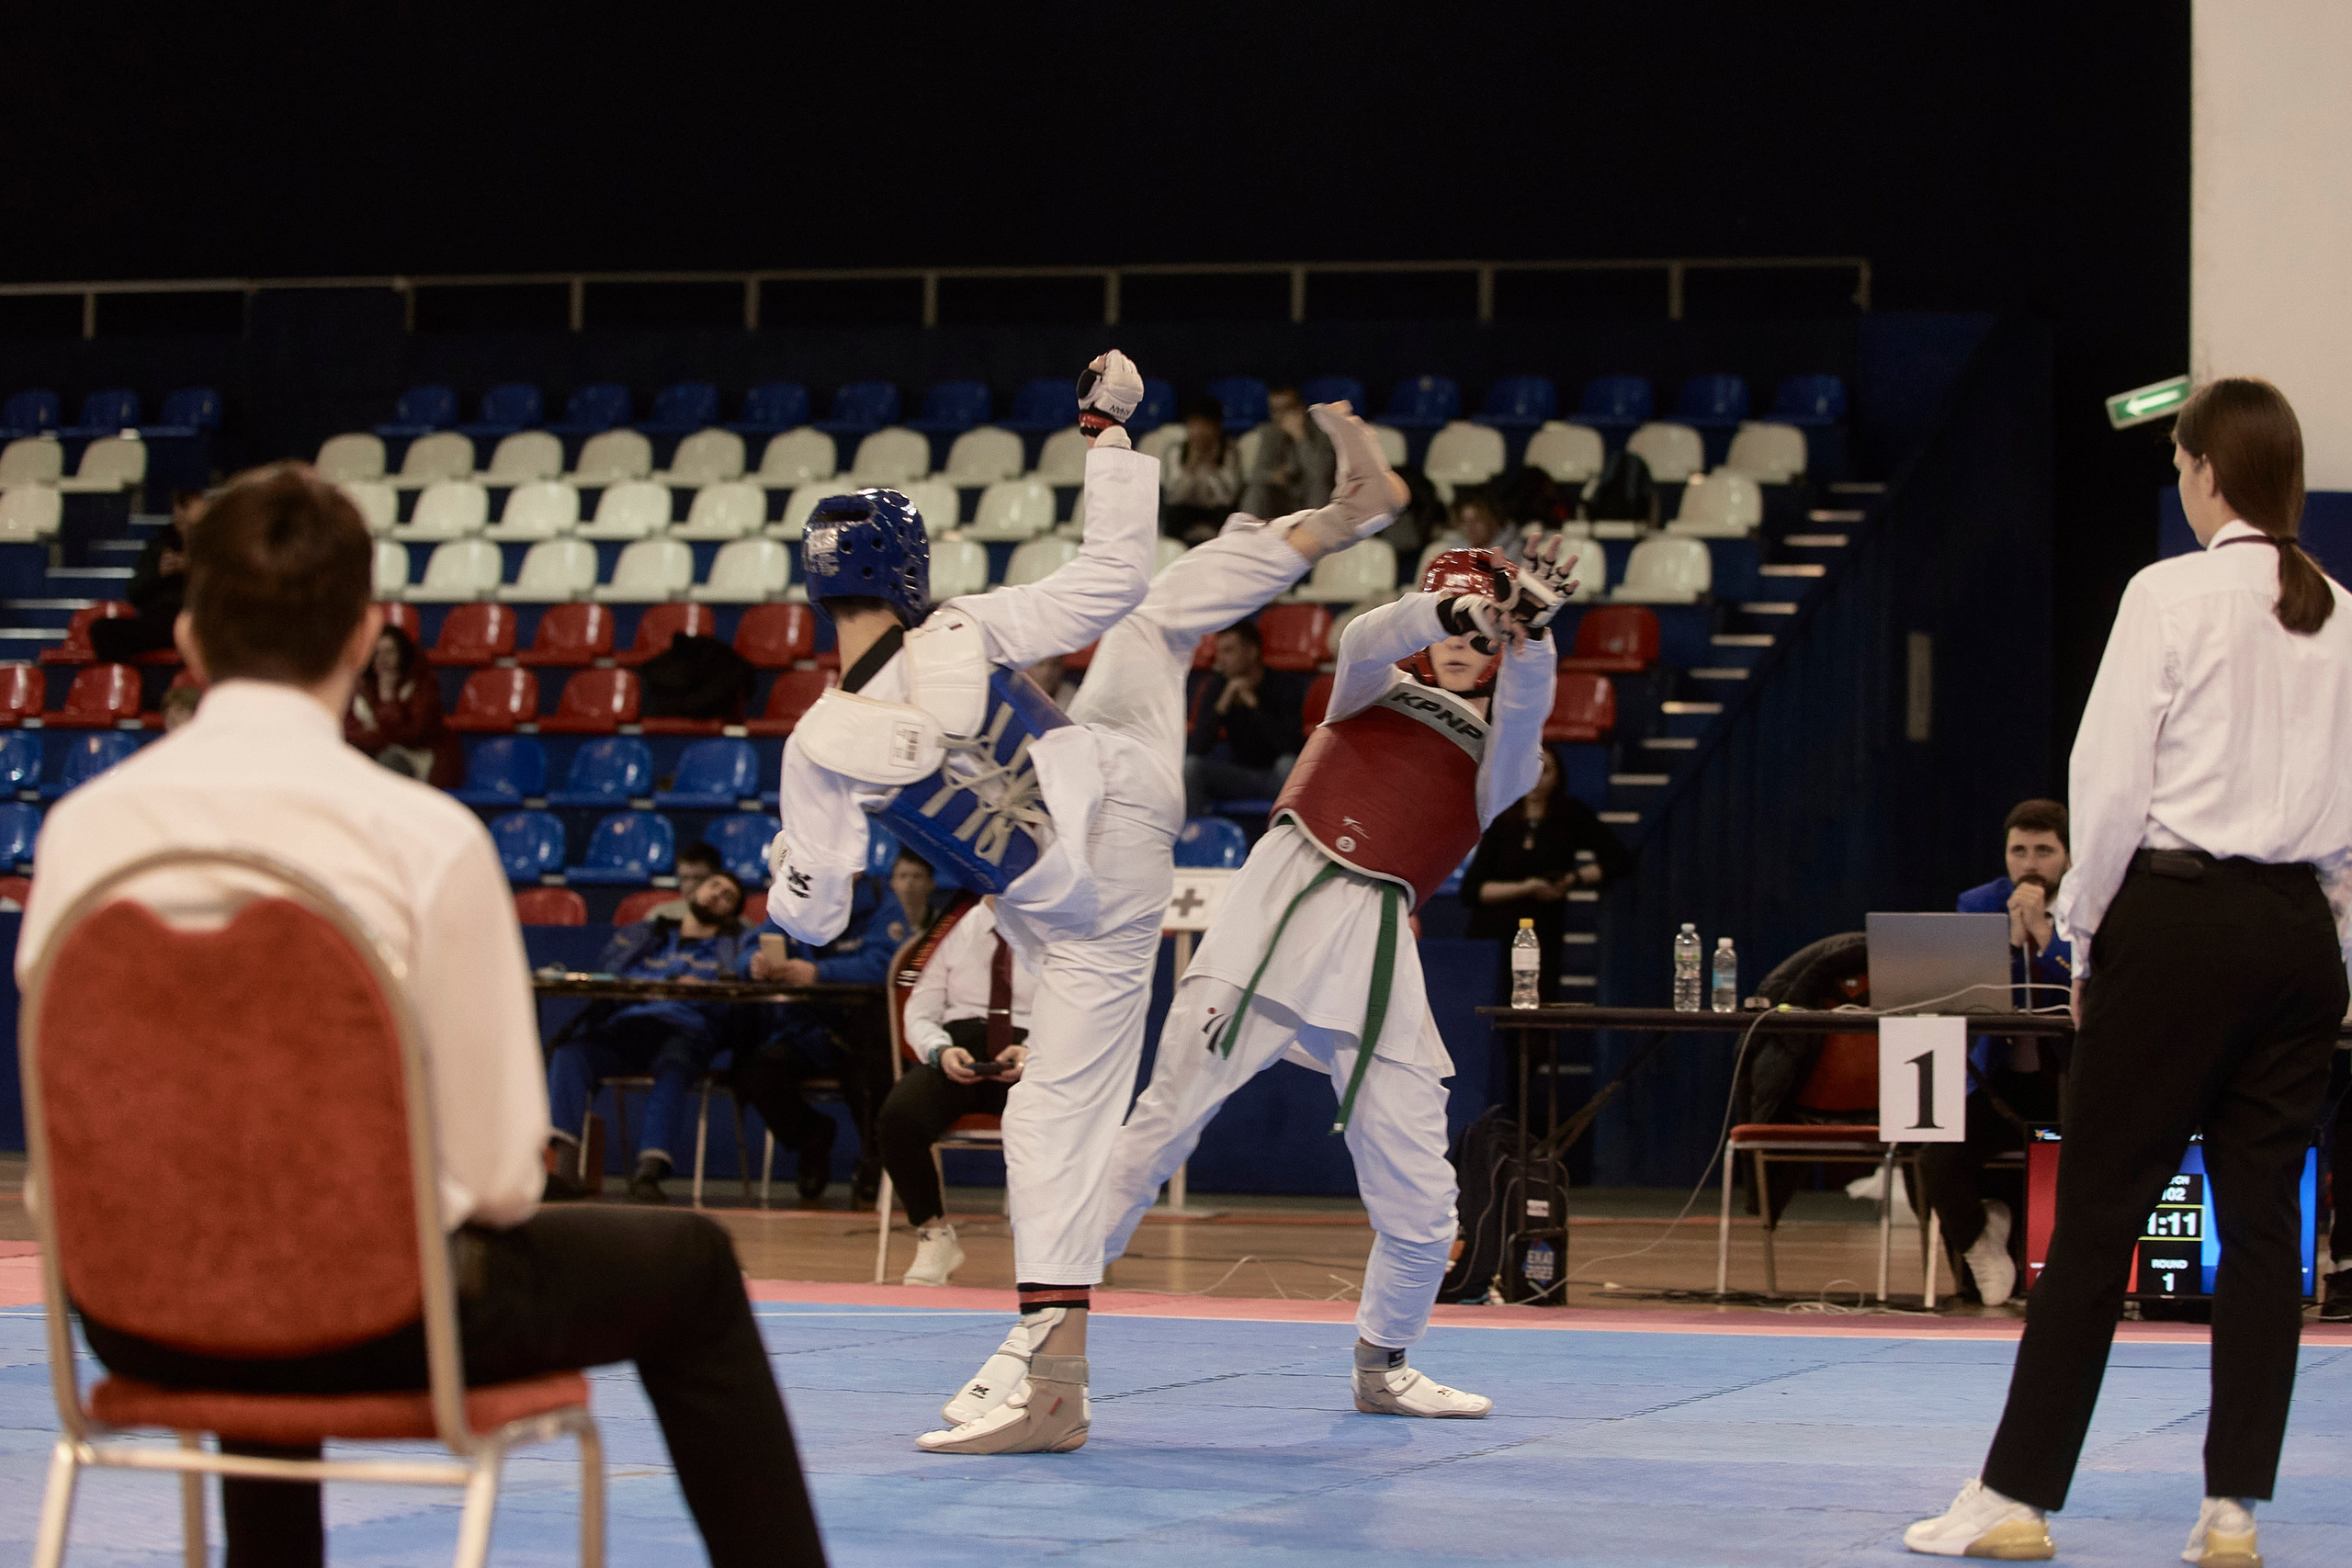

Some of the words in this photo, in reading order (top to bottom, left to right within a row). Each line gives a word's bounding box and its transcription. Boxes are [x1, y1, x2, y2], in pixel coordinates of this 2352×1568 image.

[1391, 692, 1485, 740] KPNP
[1904, 1050, 1945, 1130] 1
[2146, 1212, 2197, 1236] 1:11
[2151, 1258, 2188, 1269] ROUND
[2161, 1272, 2175, 1292] 1
